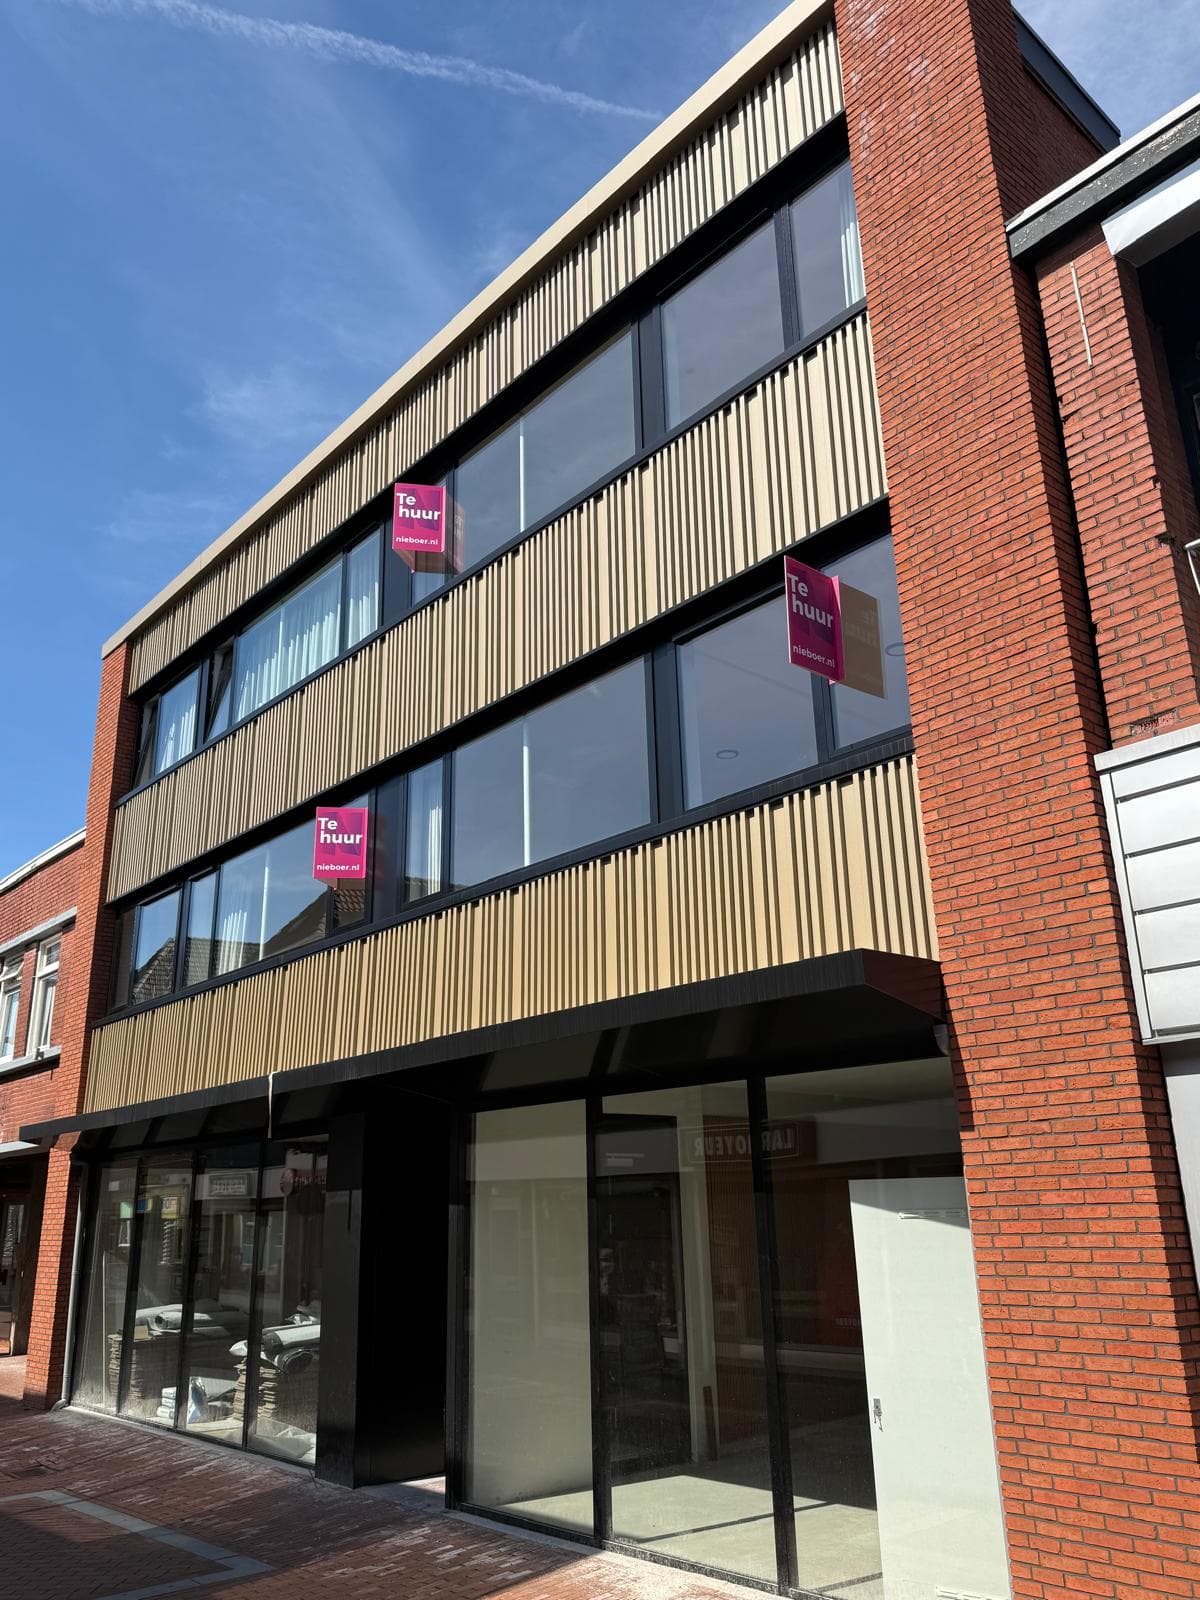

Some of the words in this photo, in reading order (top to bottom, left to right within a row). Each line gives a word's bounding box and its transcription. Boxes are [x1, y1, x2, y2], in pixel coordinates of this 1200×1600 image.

[396, 492, 417, 506] Te
[398, 504, 441, 520] huur
[395, 535, 438, 545] nieboer.nl
[787, 572, 809, 597] Te
[792, 593, 833, 628] huur
[792, 644, 835, 668] nieboer.nl
[317, 816, 338, 830] Te
[319, 829, 363, 844] huur
[316, 863, 360, 872] nieboer.nl
